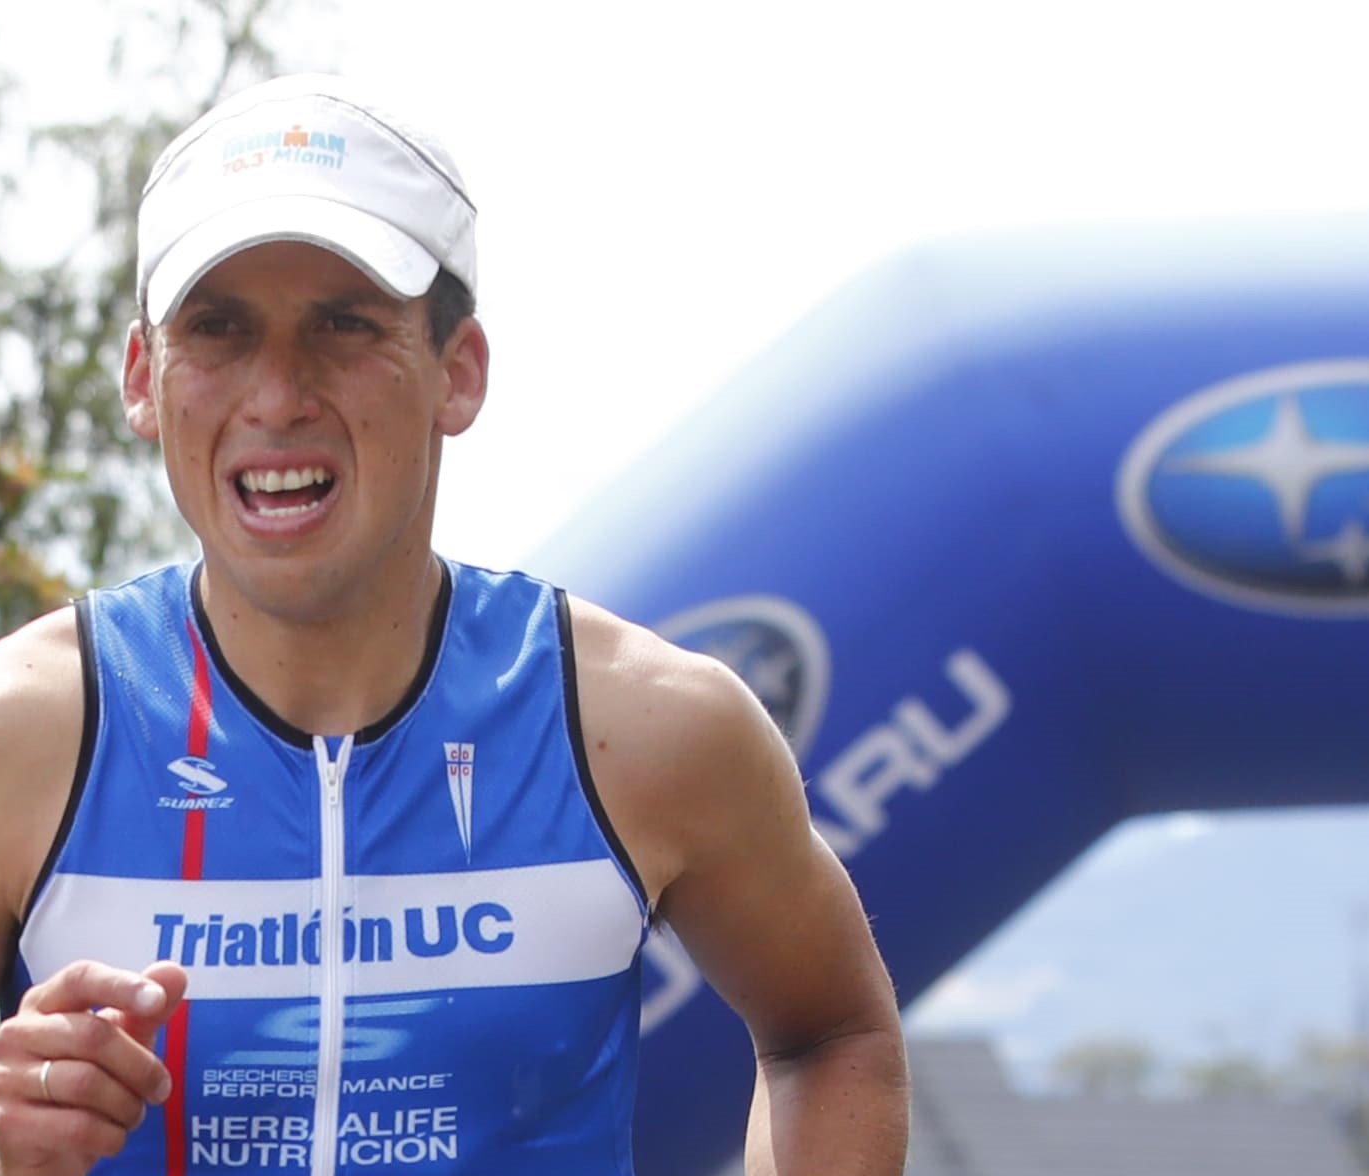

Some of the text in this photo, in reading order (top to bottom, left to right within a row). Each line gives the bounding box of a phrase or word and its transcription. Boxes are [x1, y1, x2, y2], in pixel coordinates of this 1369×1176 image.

[272, 146, 344, 169] Miami
[157, 796, 234, 810] SUAREZ
[404, 902, 515, 958] UC
[203, 1069, 317, 1083] SKECHERS
